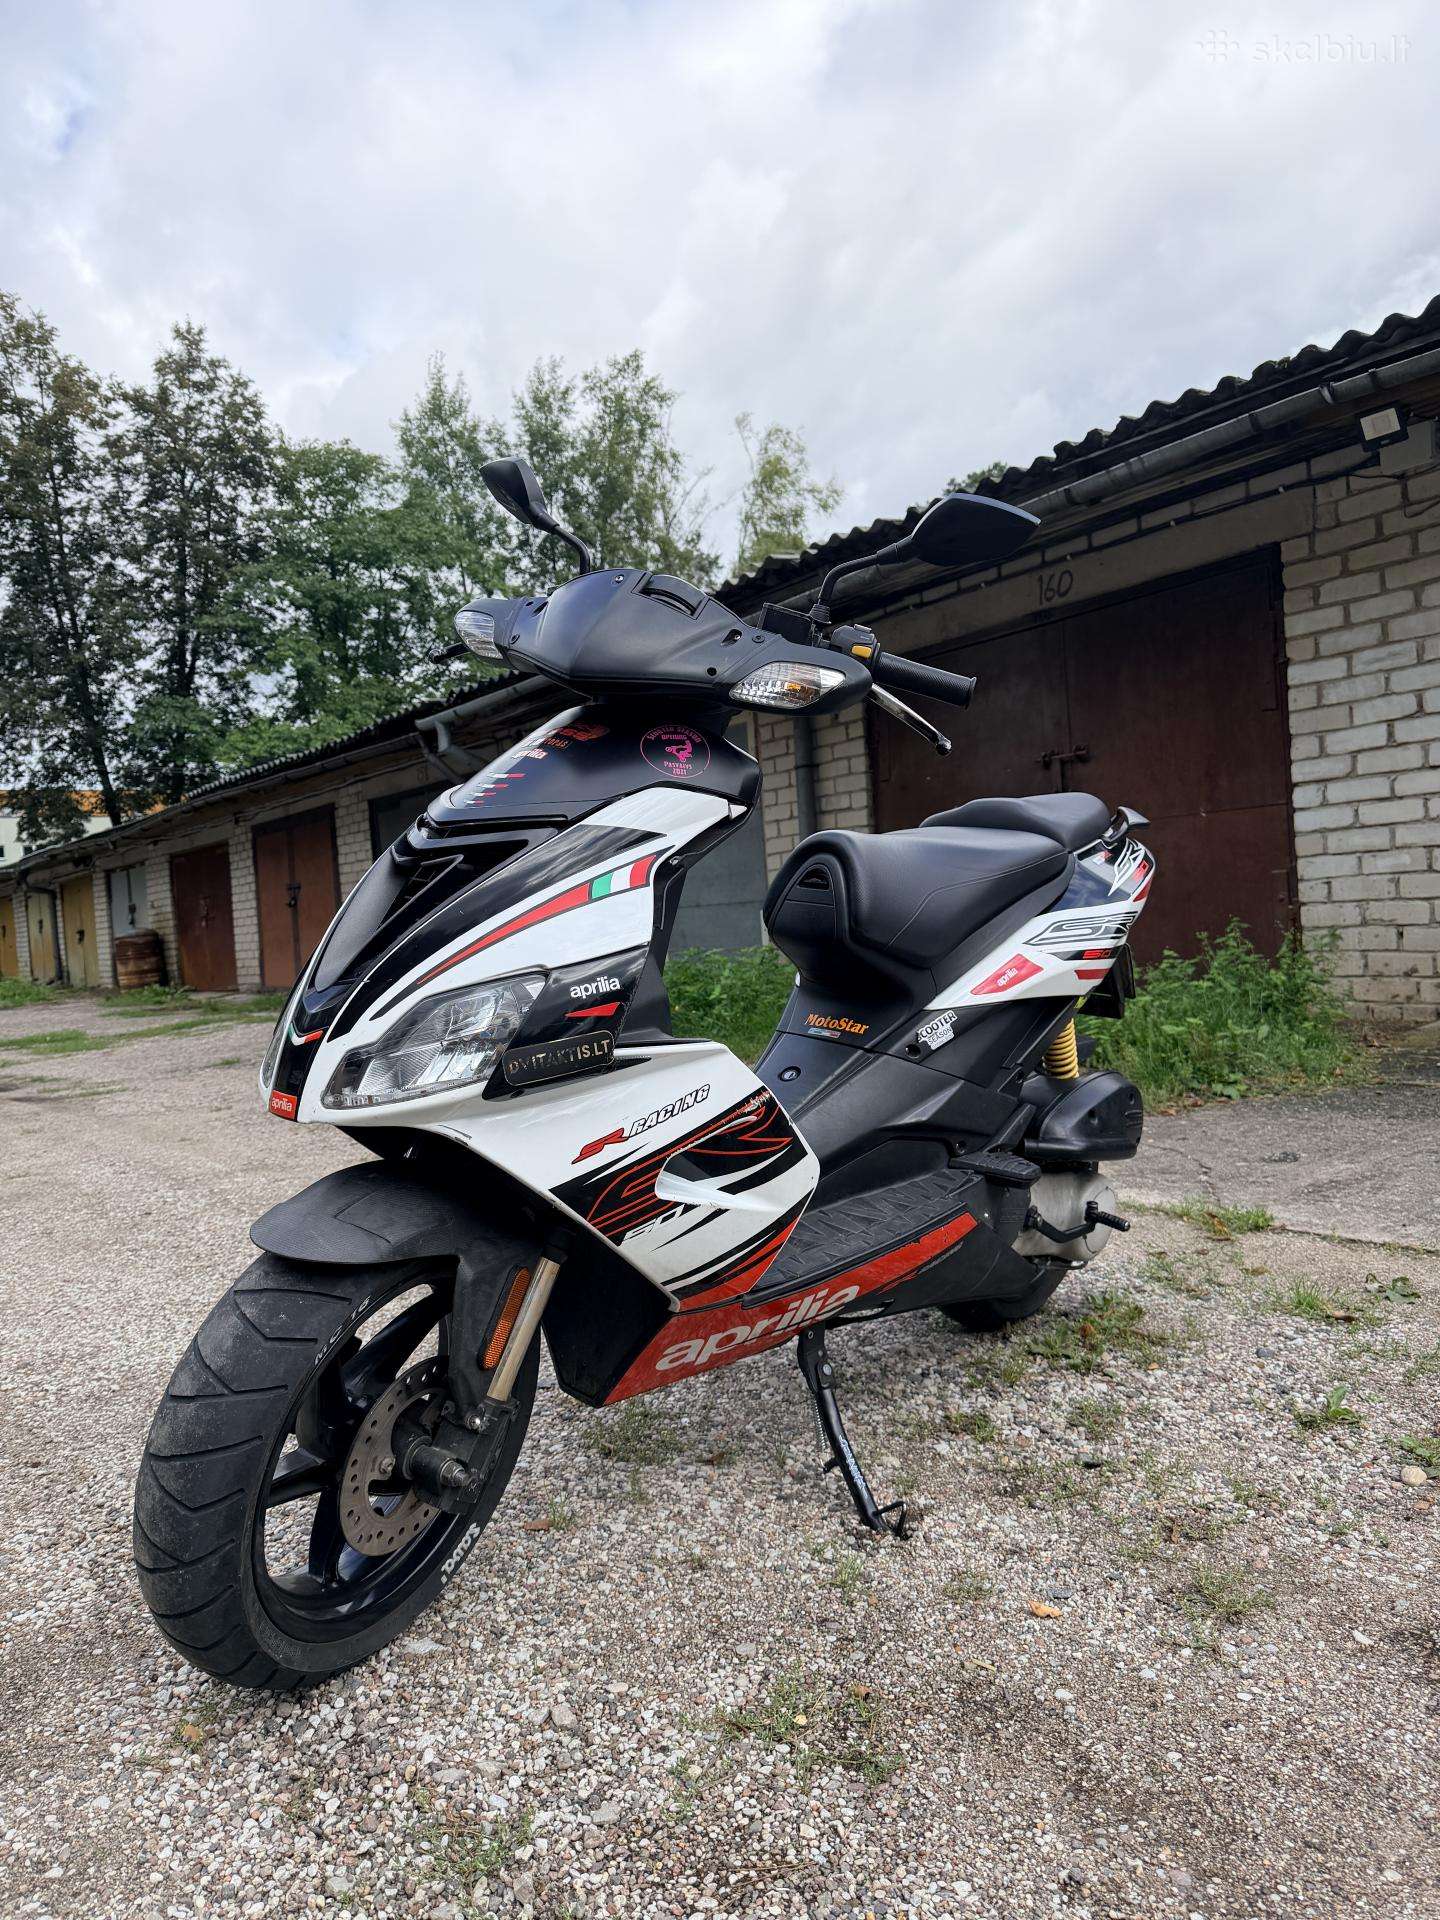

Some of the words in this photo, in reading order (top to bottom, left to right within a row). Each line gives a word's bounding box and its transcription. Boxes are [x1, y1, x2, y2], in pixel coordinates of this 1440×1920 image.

[1039, 570, 1073, 606] 160
[569, 976, 621, 999] aprilia
[997, 967, 1018, 986] aprilia
[804, 1013, 870, 1035] MotoStar
[928, 1027, 952, 1044] SEASON
[271, 1097, 293, 1112] aprilia
[628, 1083, 711, 1138] RACING
[655, 1285, 860, 1371] aprilia
